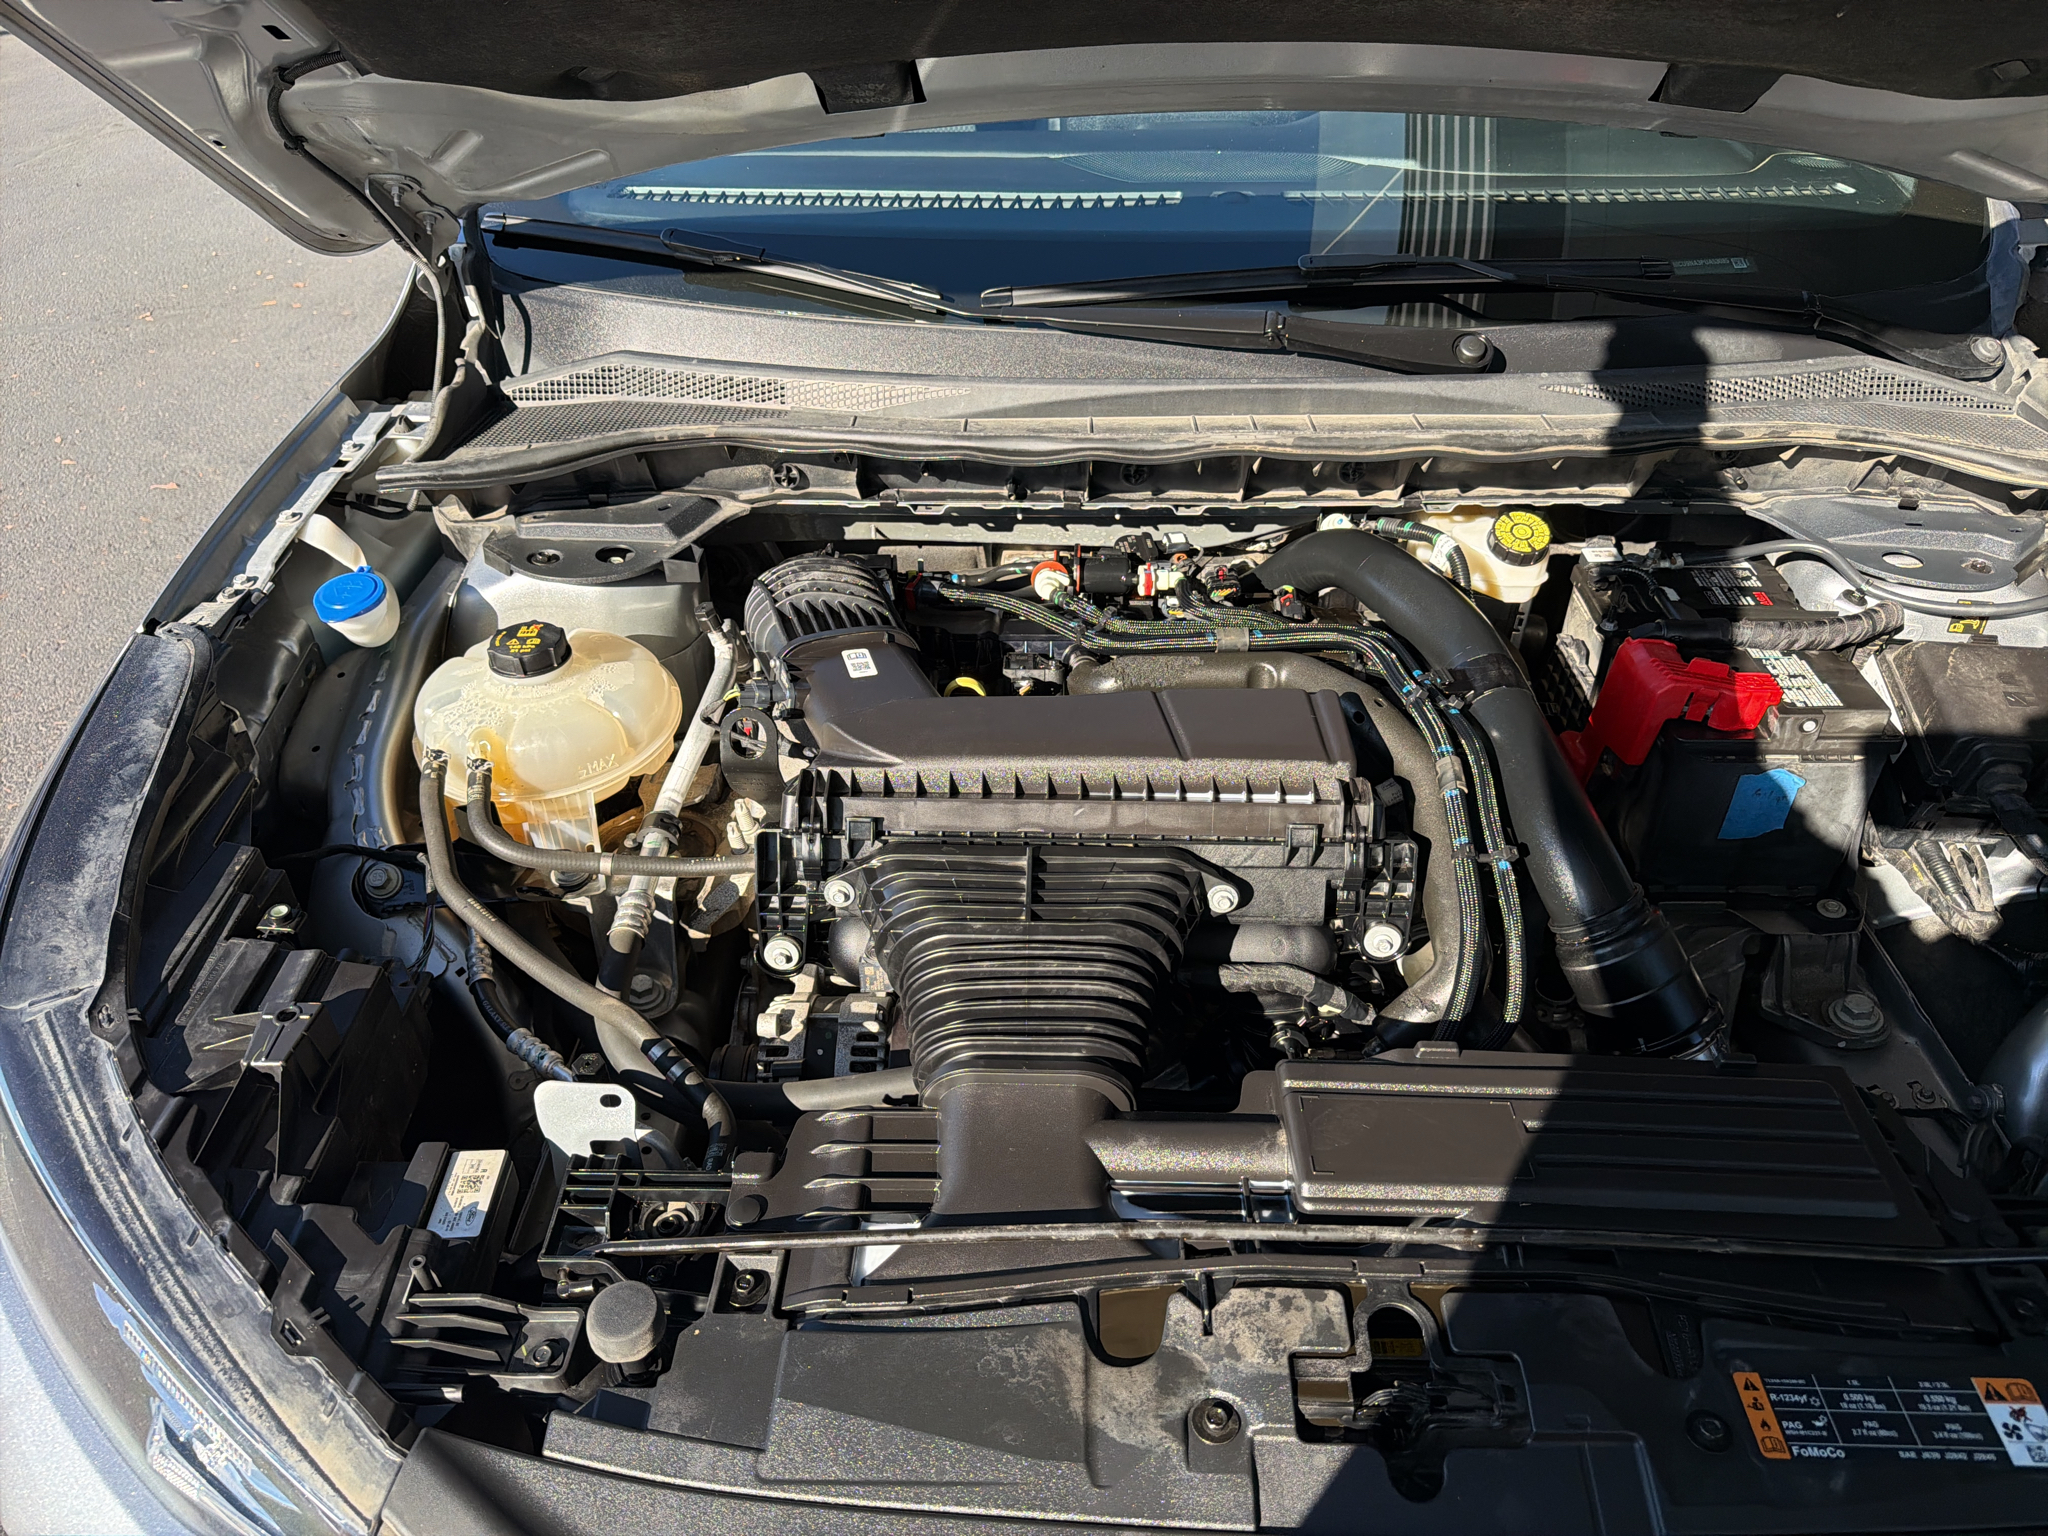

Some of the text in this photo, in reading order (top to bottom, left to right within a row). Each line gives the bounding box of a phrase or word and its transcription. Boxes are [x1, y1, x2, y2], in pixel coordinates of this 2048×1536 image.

[586, 754, 620, 774] MAX
[482, 1000, 503, 1023] GALAXY
[1770, 1393, 1808, 1404] R-1234yf
[1782, 1420, 1803, 1429] PAG
[1791, 1446, 1846, 1459] FoMoCo
